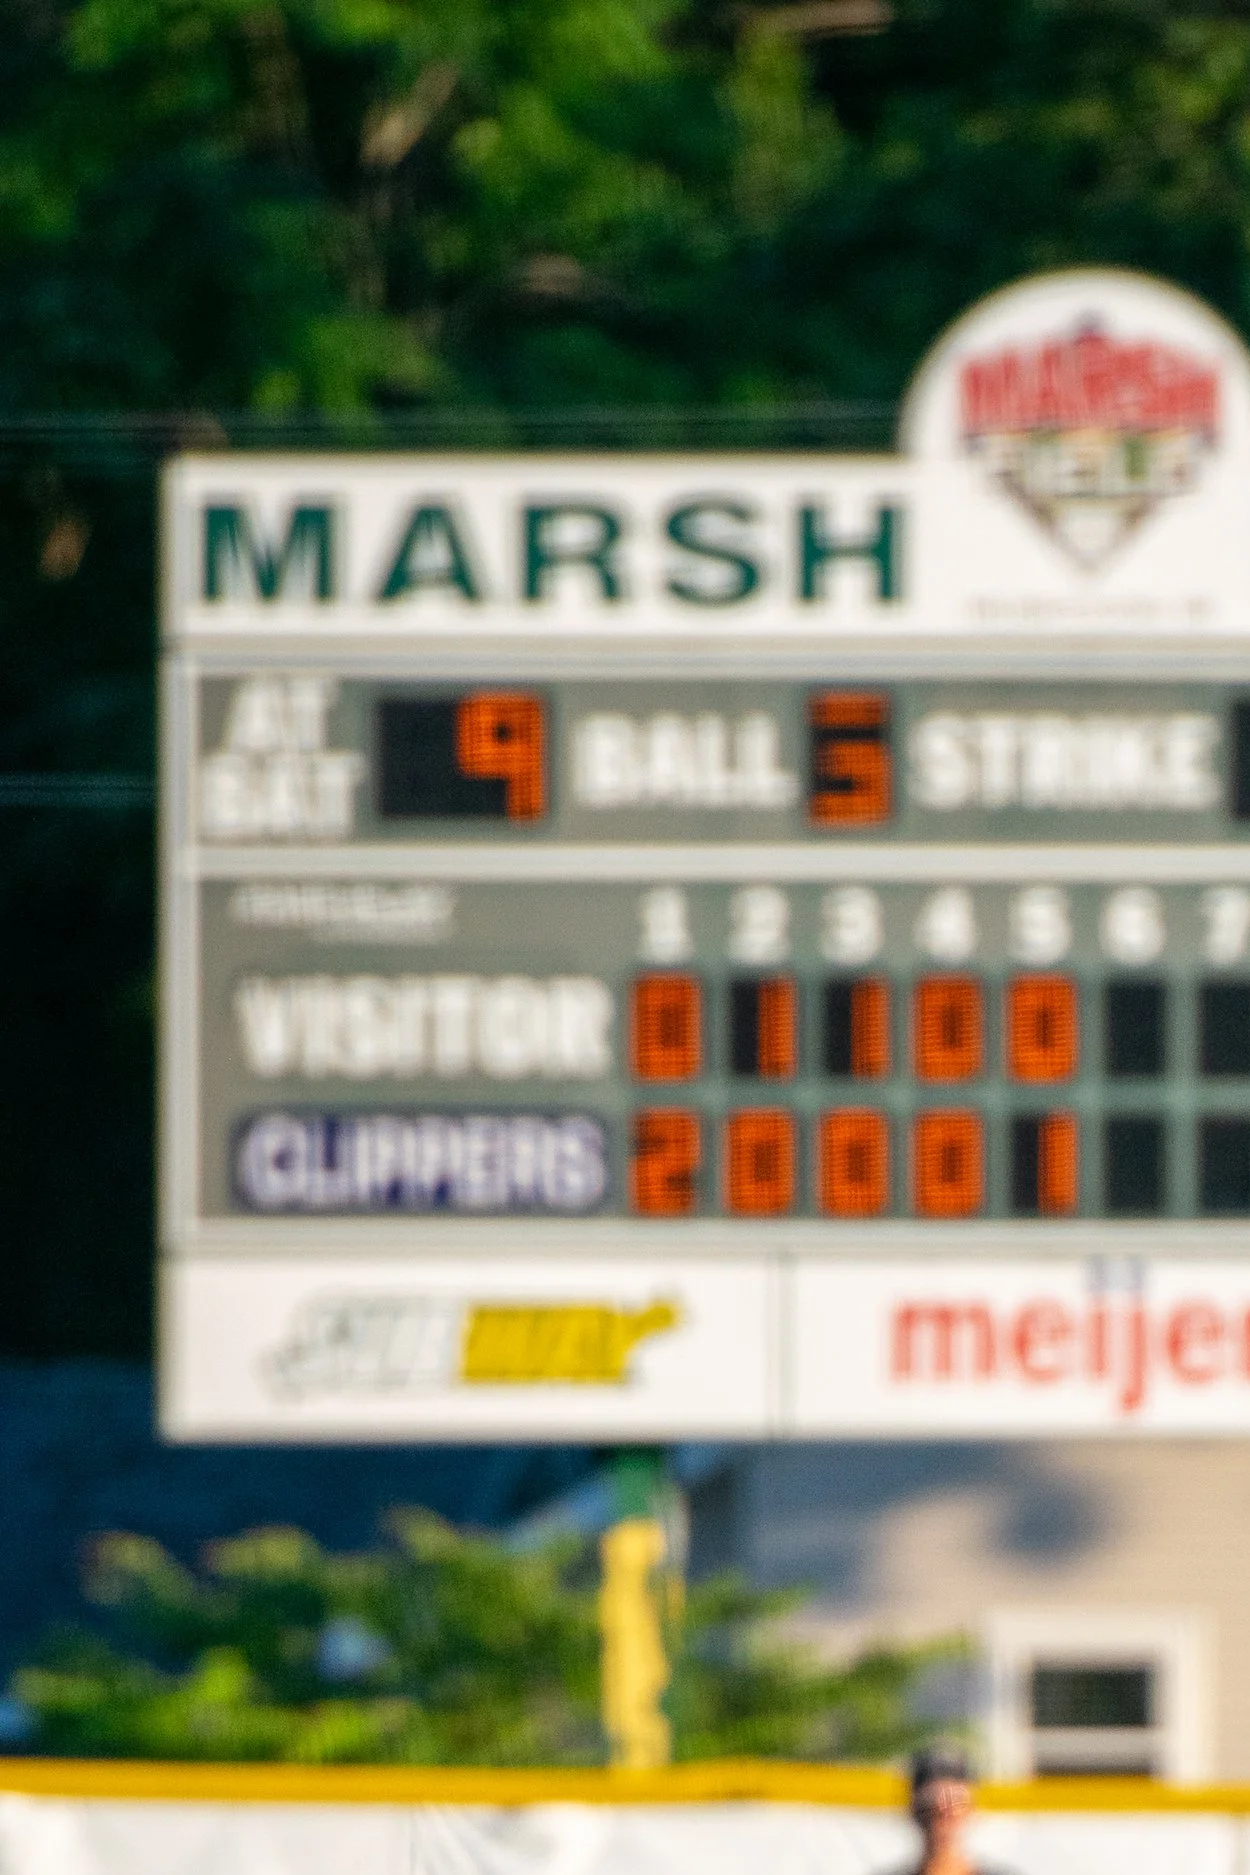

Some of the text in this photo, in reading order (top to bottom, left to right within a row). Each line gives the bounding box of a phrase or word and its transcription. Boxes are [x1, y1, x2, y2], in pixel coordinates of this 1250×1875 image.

[203, 498, 902, 605] MARSH
[455, 692, 546, 822] 9
[576, 712, 794, 806] BALL
[913, 712, 1220, 808] STRIKE
[640, 889, 688, 962] 1
[738, 889, 786, 962] 2
[832, 889, 880, 962] 3
[924, 889, 973, 962] 4
[1016, 889, 1067, 962] 5
[1105, 889, 1161, 962] 6
[237, 977, 612, 1077] VISITOR
[632, 974, 700, 1081] 0
[760, 974, 795, 1079] 1
[853, 974, 888, 1079] 1
[914, 976, 982, 1081] 0
[1008, 976, 1077, 1081] 0
[243, 1116, 607, 1211] CLIPPERS
[632, 1110, 700, 1215] 2
[726, 1110, 795, 1216] 0
[819, 1110, 888, 1217] 0
[914, 1110, 982, 1217] 0
[1040, 1112, 1077, 1215] 1
